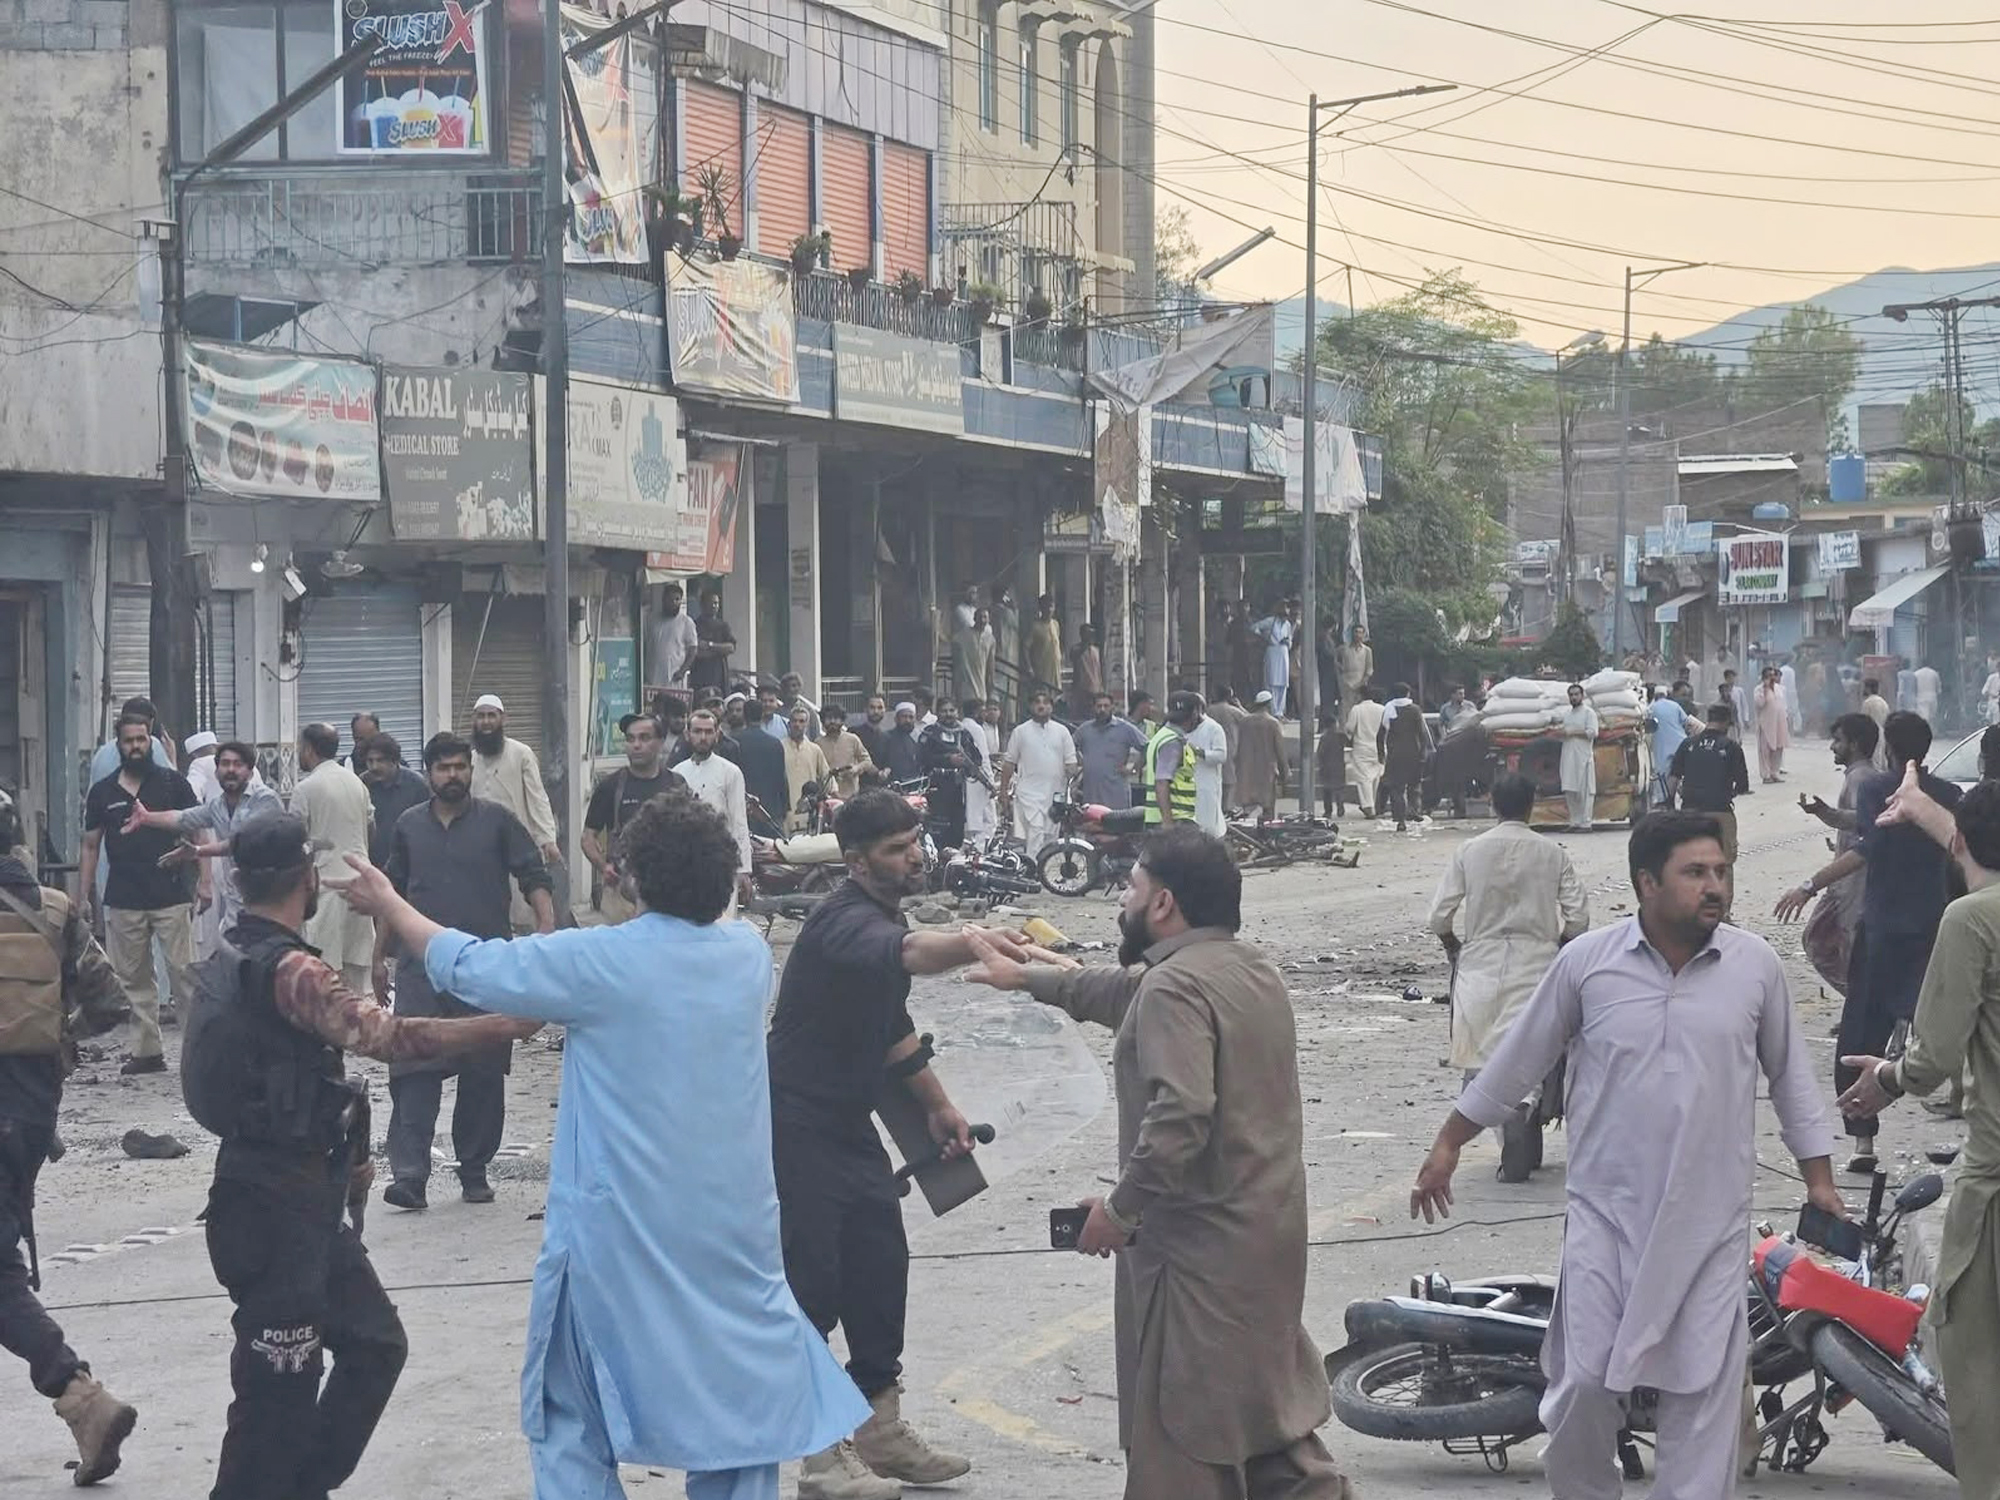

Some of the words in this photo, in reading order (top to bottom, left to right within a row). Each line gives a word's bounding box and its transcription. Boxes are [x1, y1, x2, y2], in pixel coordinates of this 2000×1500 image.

[384, 376, 458, 419] KABAL
[382, 434, 429, 456] MEDICAL
[431, 435, 459, 456] STORE
[263, 1325, 314, 1343] POLICE
